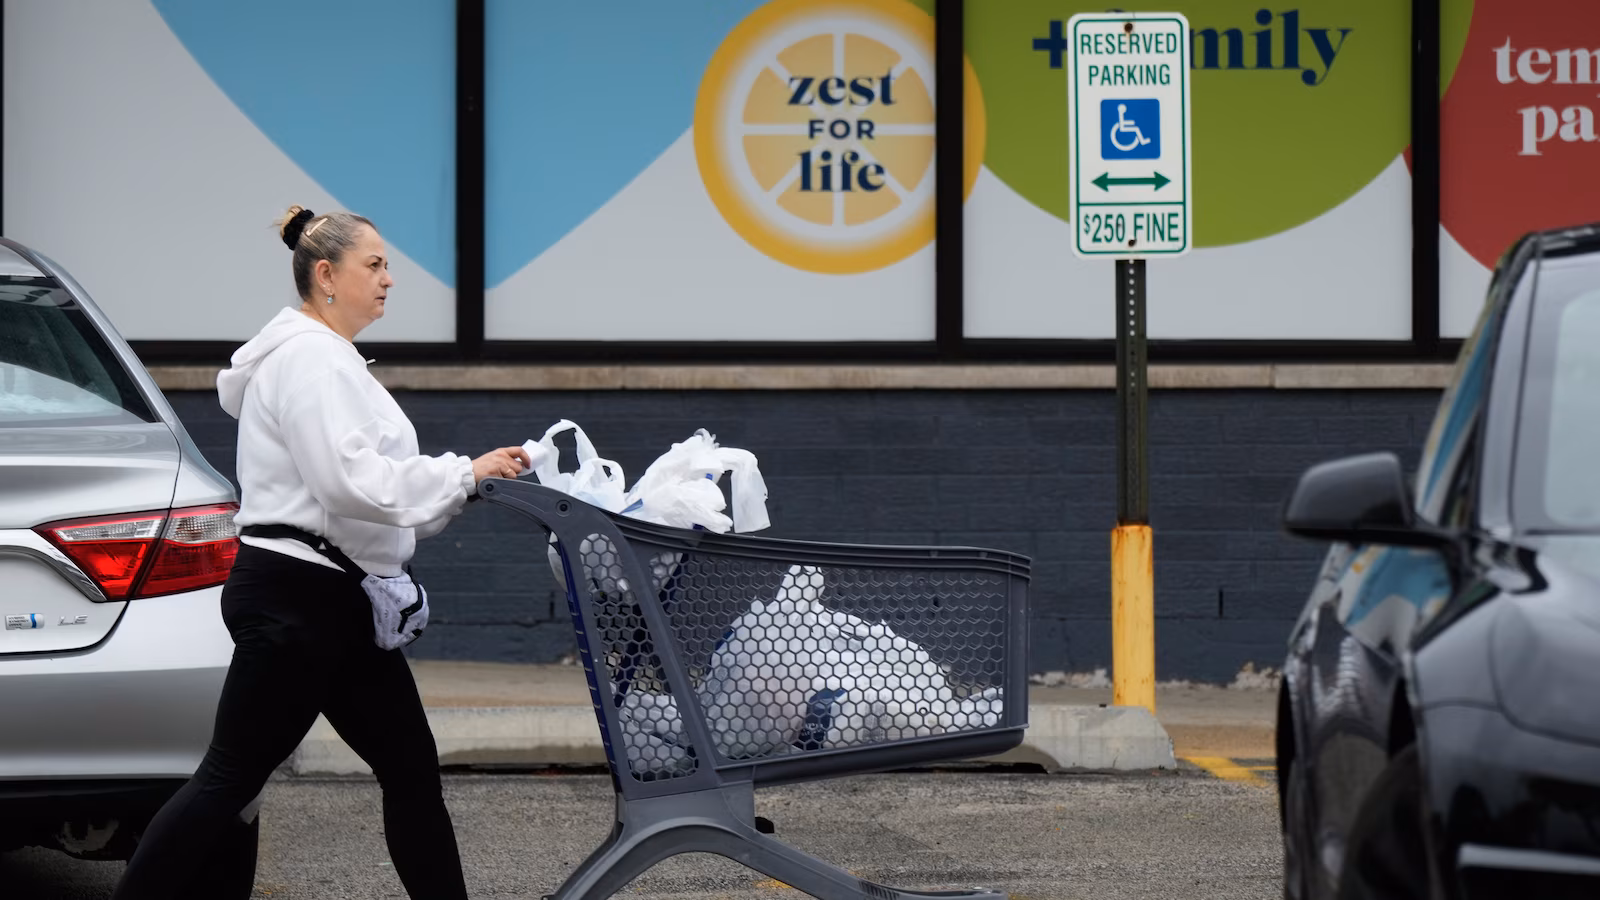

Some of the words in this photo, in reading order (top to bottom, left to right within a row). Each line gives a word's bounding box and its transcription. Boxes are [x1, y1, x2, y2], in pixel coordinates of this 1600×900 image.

[1080, 32, 1178, 55] RESERVED
[1105, 8, 1354, 86] mily
[1492, 34, 1600, 85] tem
[787, 67, 897, 106] zest
[1088, 63, 1171, 86] PARKING
[808, 119, 876, 140] FOR
[1516, 94, 1600, 157] pa
[797, 149, 886, 193] life
[1083, 213, 1126, 243] $250
[1133, 212, 1180, 243] FINE
[57, 614, 89, 627] LE
